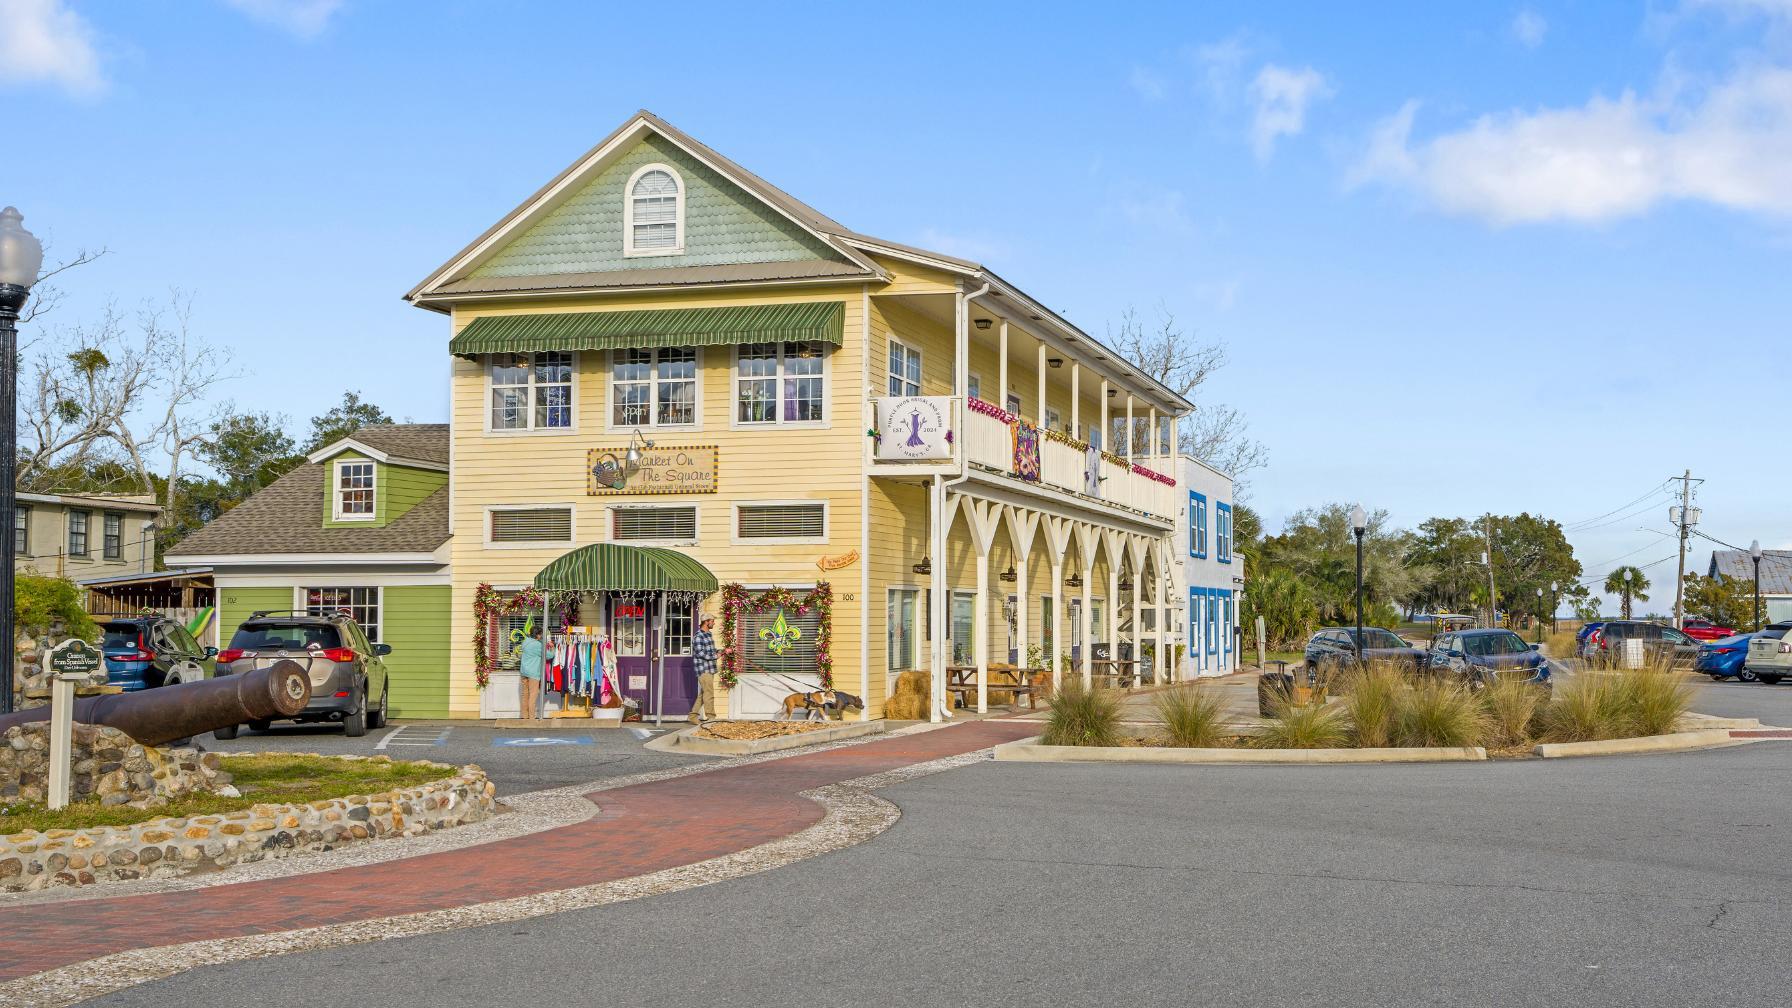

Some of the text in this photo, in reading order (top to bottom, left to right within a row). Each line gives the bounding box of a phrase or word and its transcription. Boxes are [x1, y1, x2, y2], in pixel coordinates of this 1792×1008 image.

[676, 453, 695, 466] On
[639, 467, 712, 484] The Square
[842, 593, 855, 601] 100
[615, 604, 646, 619] OPEN
